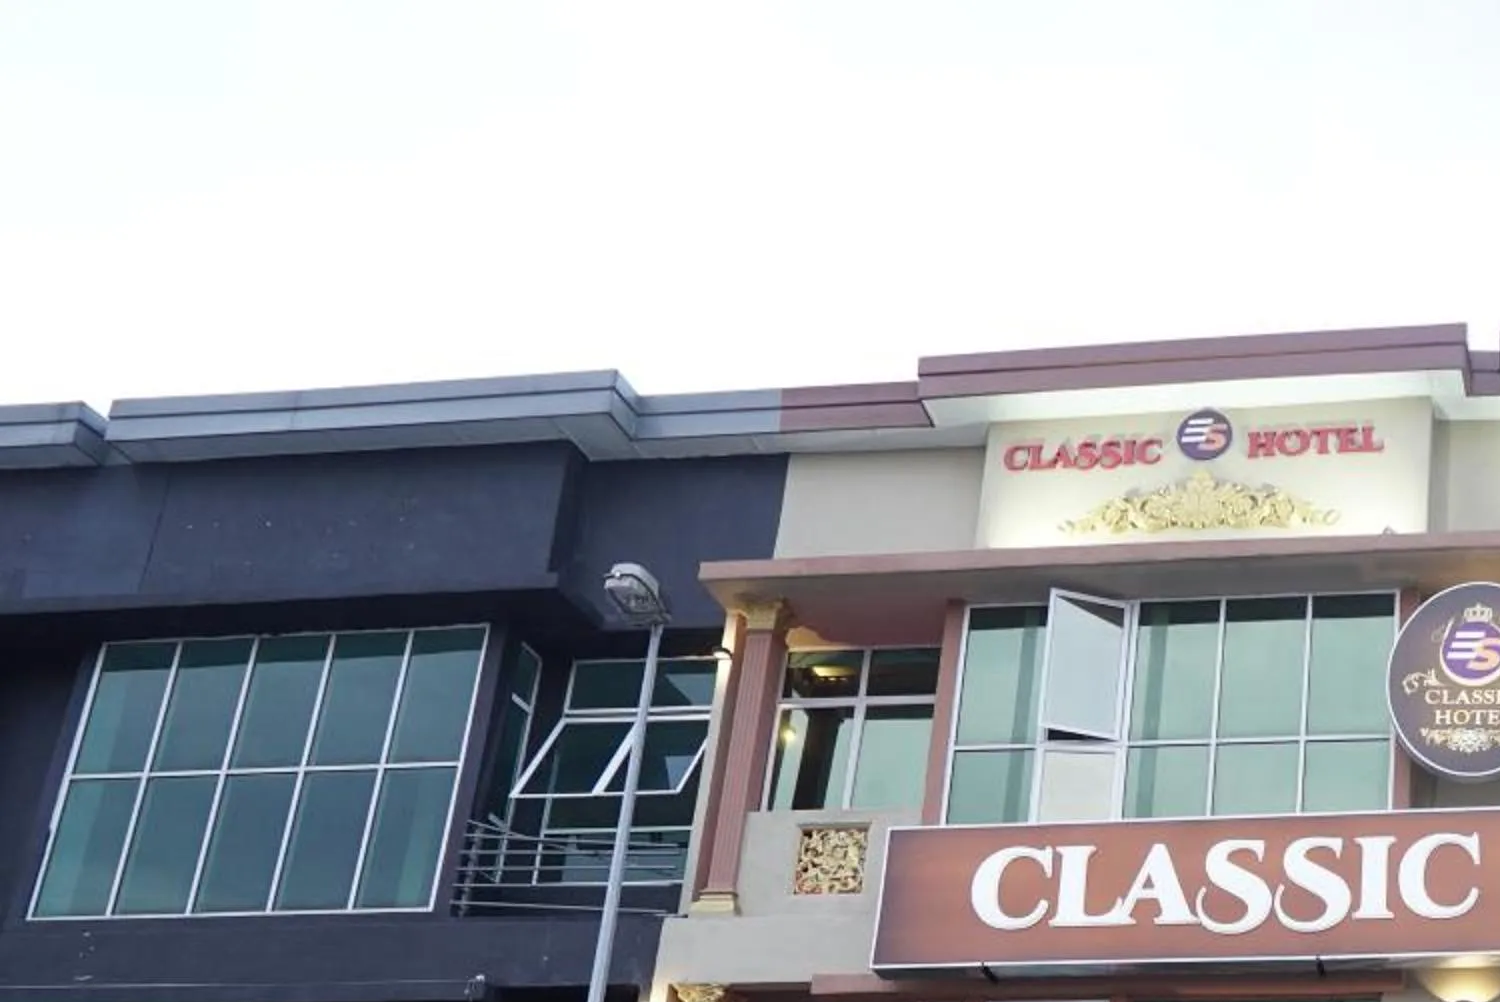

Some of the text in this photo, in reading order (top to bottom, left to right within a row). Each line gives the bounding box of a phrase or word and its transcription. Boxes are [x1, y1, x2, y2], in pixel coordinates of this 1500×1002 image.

[1003, 437, 1164, 472] CLASSIC
[1247, 425, 1385, 460] HOTEL
[970, 831, 1481, 935] CLASSIC
